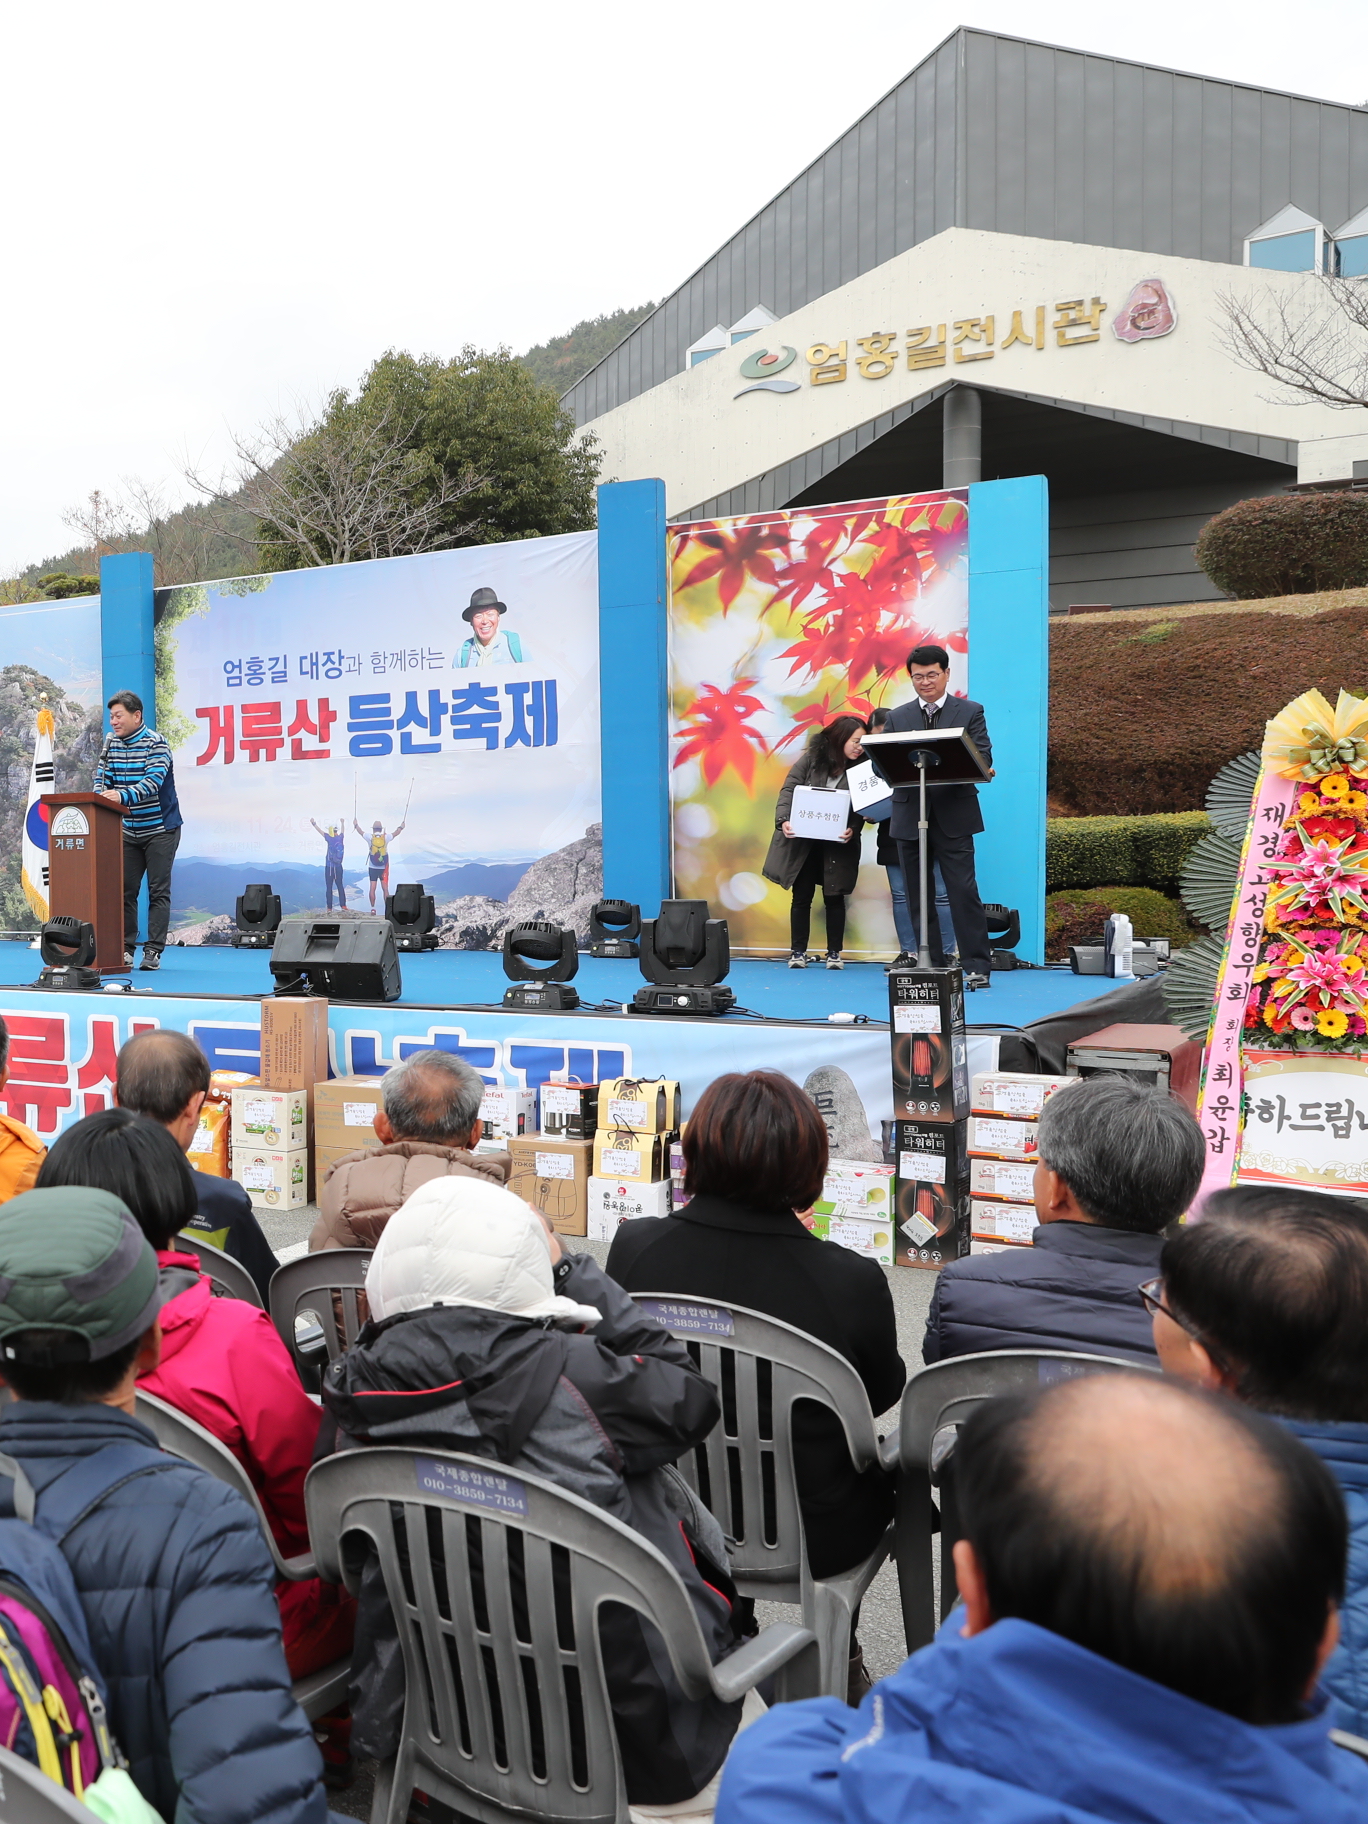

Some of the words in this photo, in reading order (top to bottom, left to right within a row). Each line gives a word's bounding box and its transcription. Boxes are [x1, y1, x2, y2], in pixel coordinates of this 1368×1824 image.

[805, 296, 1107, 386] 엄홍길전시관
[223, 653, 289, 688] 엄홍길
[299, 648, 362, 681] 대장과
[370, 646, 445, 675] 함께하는
[195, 696, 337, 766] 거류산
[346, 679, 558, 757] 등산축제
[858, 774, 885, 792] 경품
[798, 809, 840, 822] 상품추첨함
[55, 838, 85, 850] 거류면
[897, 988, 940, 1000] 타워히터
[1222, 1018, 1240, 1053] 회장
[484, 1091, 504, 1099] efal
[1206, 1061, 1235, 1154] 최윤갑
[903, 1136, 945, 1150] 타워히터
[657, 1304, 719, 1320] 국제종합렌탈
[651, 1315, 731, 1333] 10-3859-7134
[434, 1464, 508, 1492] 국제종합렌탈
[424, 1477, 525, 1511] 010-3859-7134
